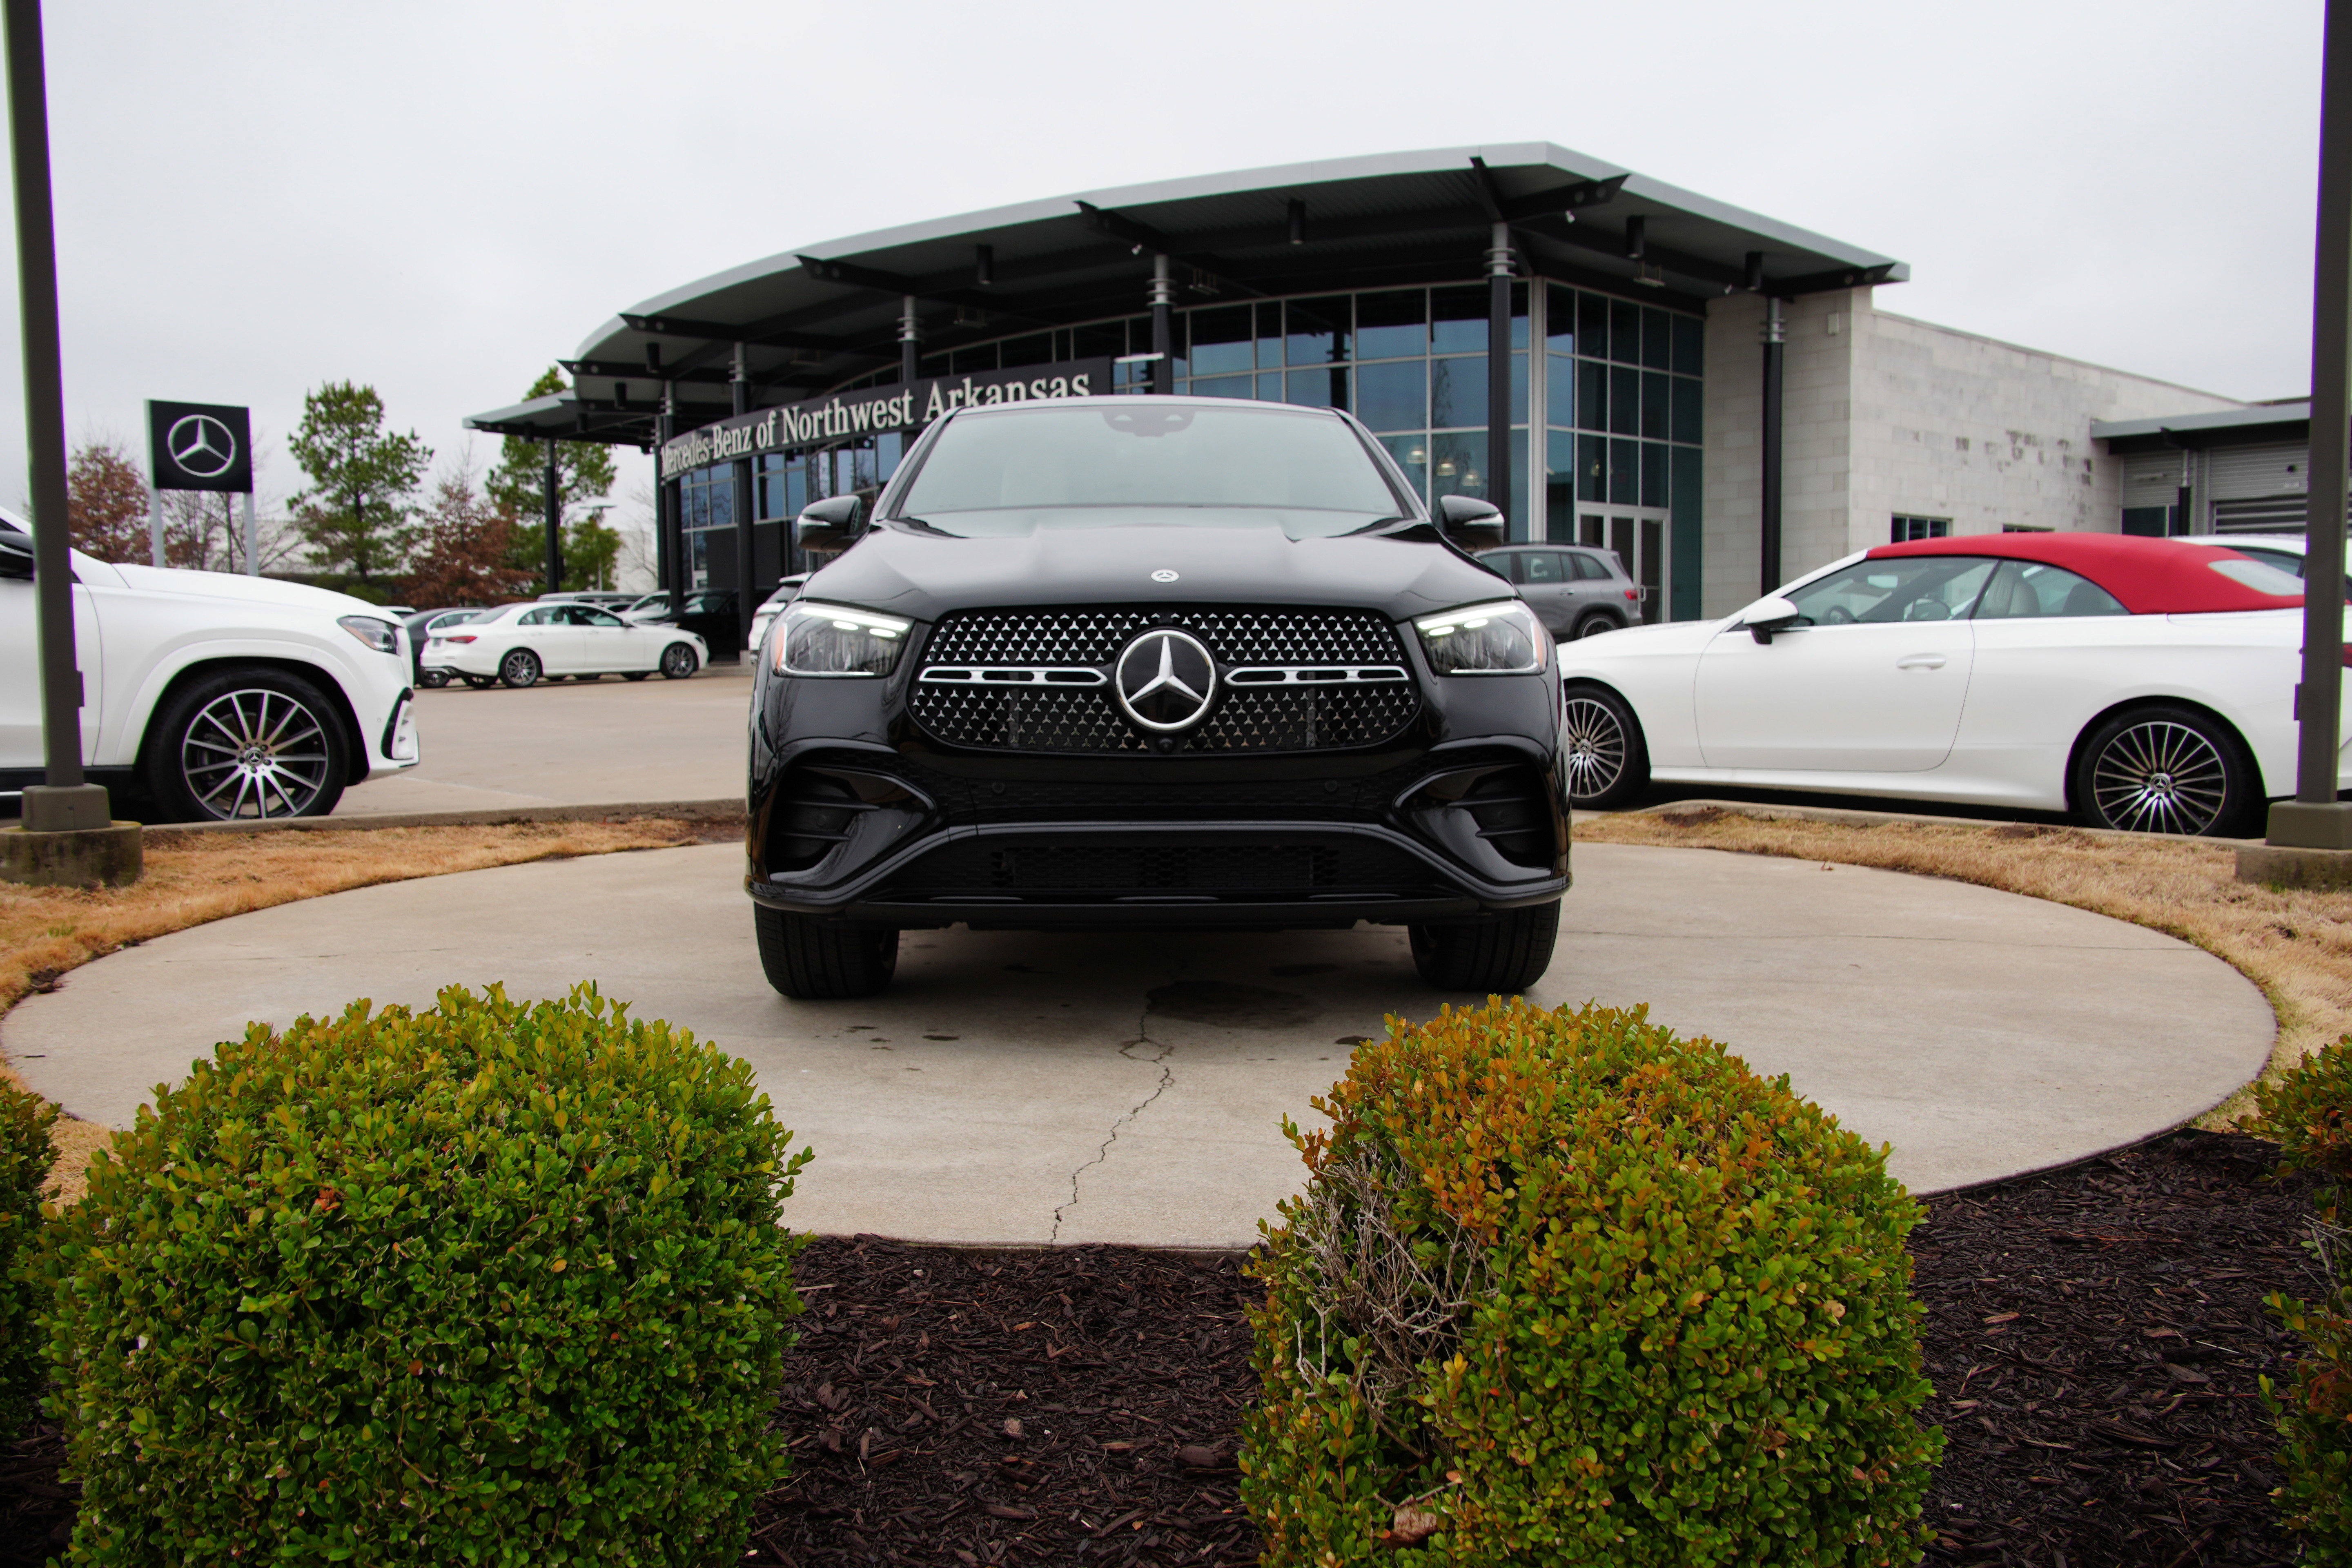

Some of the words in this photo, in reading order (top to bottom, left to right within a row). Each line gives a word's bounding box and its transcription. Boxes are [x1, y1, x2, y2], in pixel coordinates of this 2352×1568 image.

[661, 425, 752, 477] Mercedes-Benz
[756, 410, 777, 449] of
[781, 388, 914, 444] Northwest
[922, 373, 1090, 422] Arkansas
